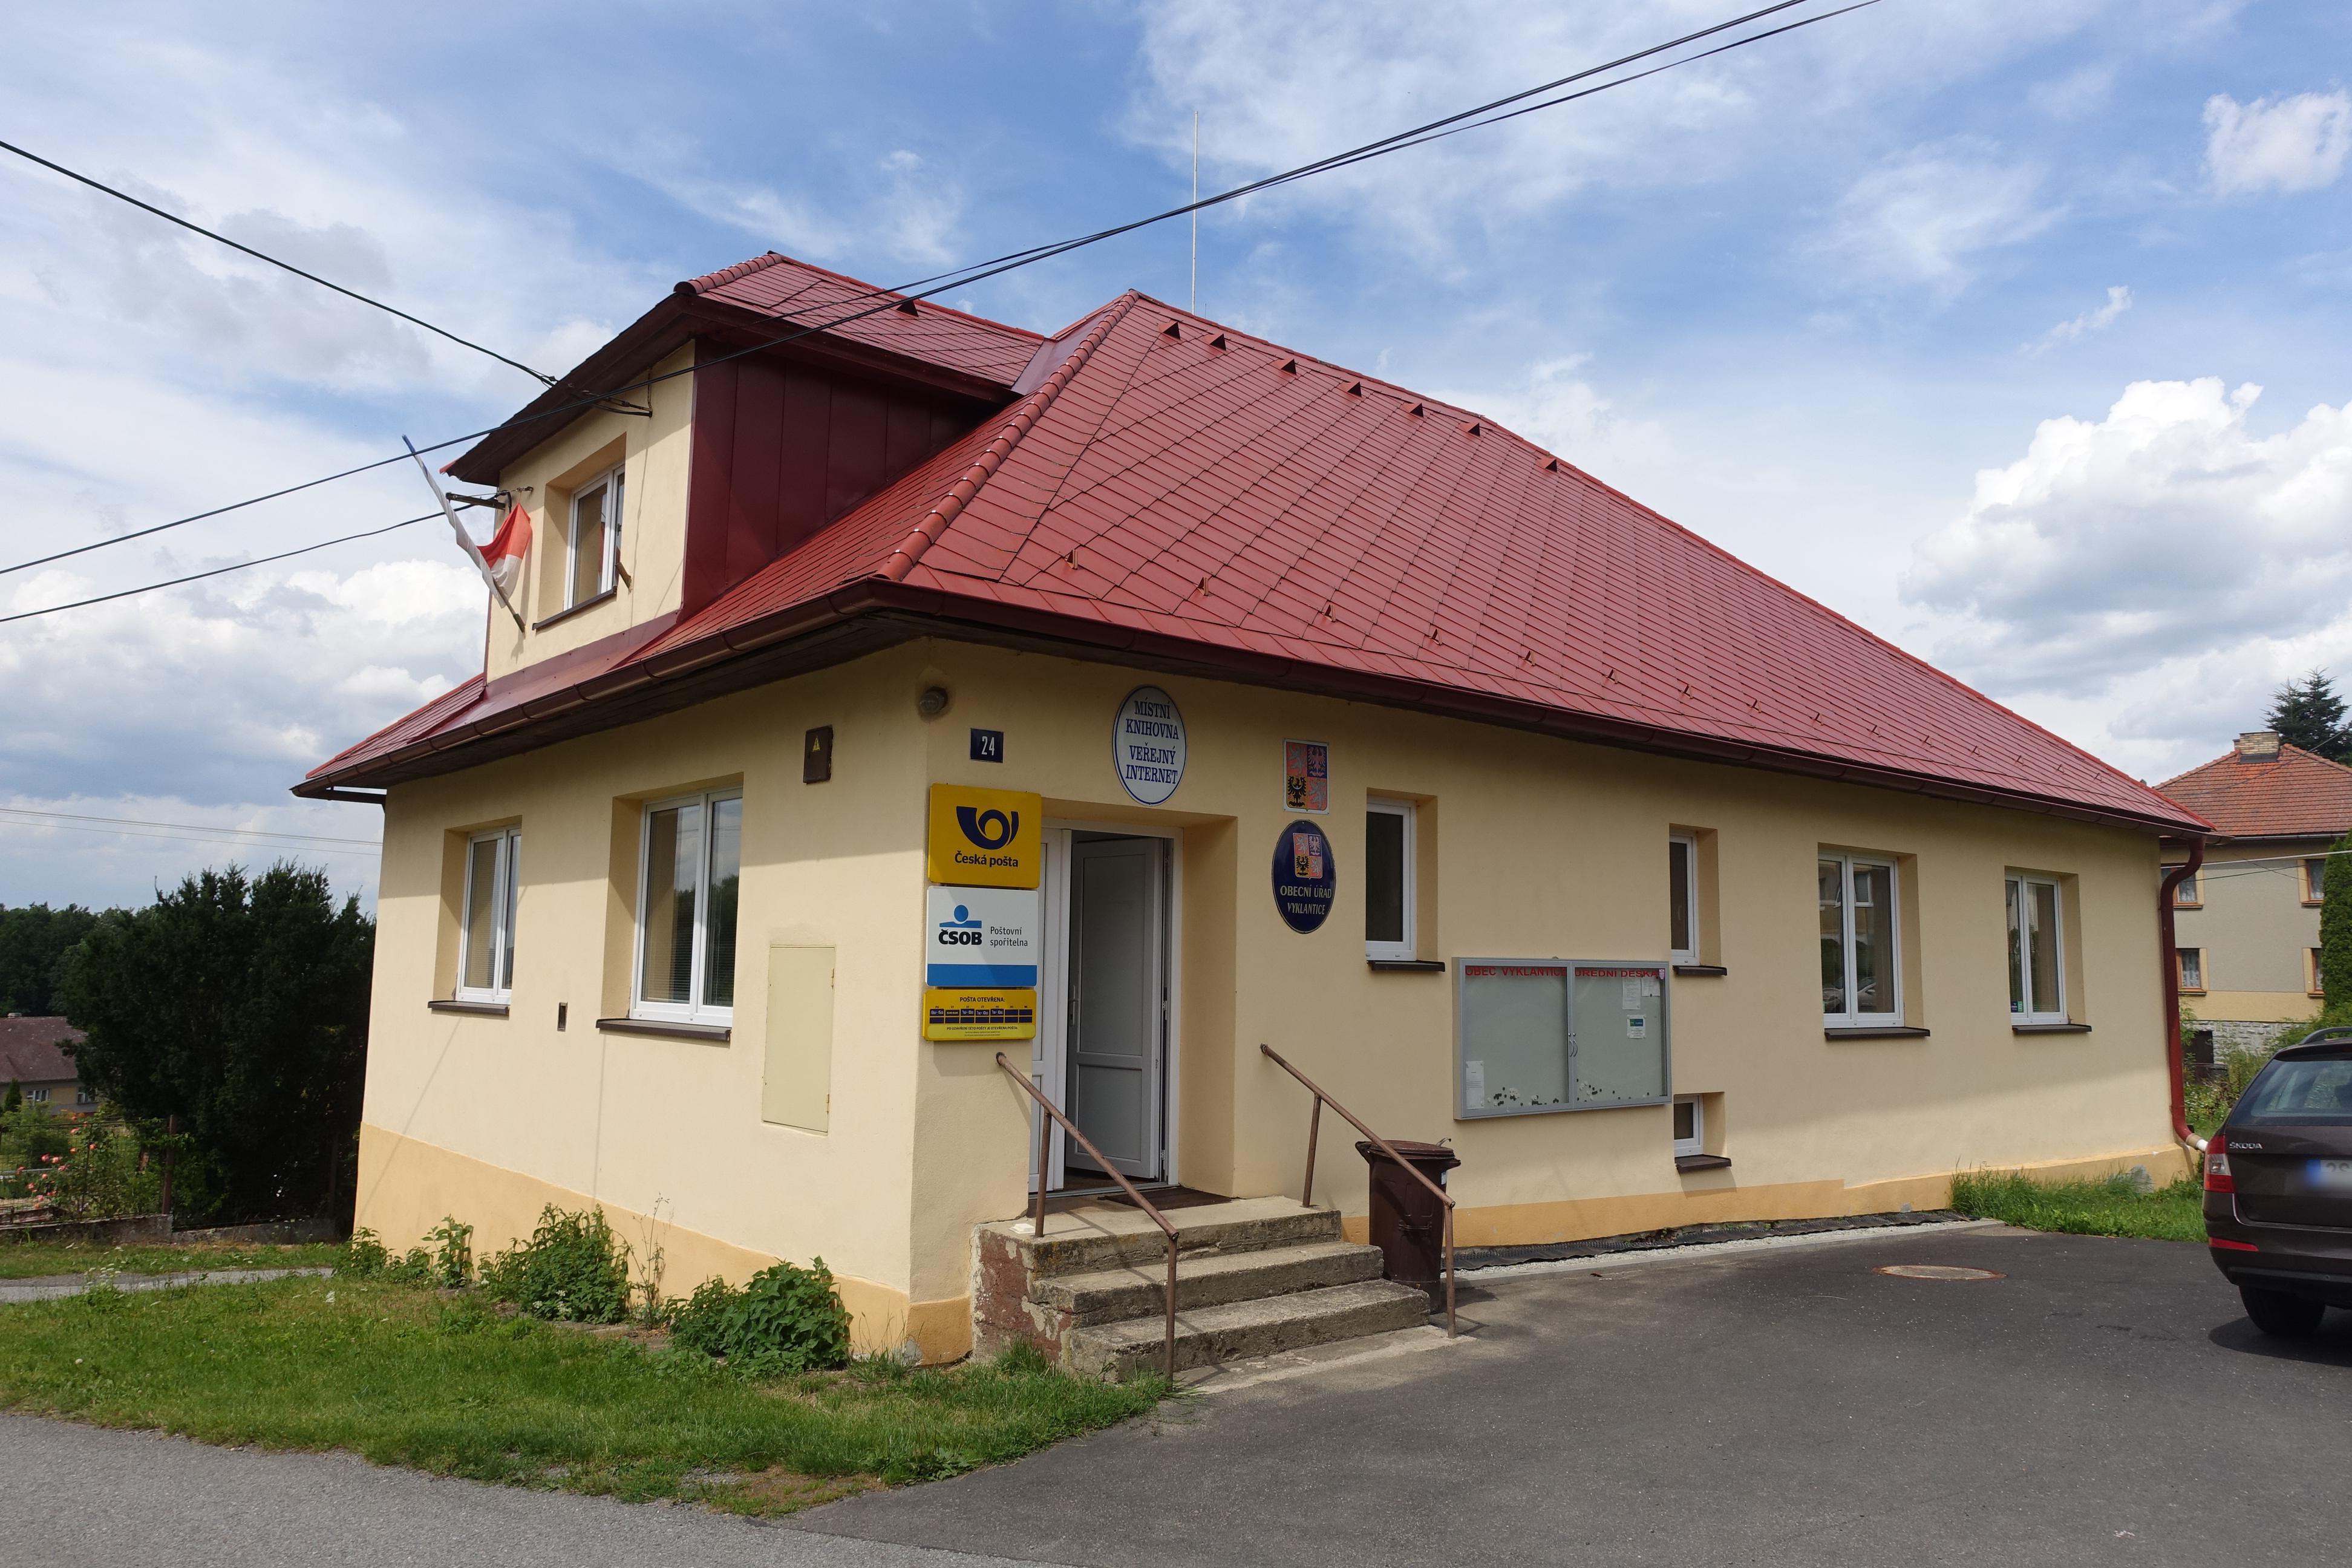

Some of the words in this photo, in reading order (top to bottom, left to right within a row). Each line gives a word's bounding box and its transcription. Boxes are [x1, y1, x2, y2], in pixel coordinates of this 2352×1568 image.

[1134, 697, 1171, 719] MÍSTNÍ
[1126, 718, 1179, 740] KNIHOVNA
[981, 736, 995, 756] 24
[1129, 742, 1176, 765] VEŘEJNÝ
[1125, 764, 1178, 784] INTERNET
[955, 851, 987, 865] Česká
[989, 856, 1019, 867] pošta
[1280, 884, 1312, 898] OBECNÍ
[1314, 885, 1331, 898] ÚŘAD
[1287, 902, 1325, 915] VYKLANTICE
[938, 929, 982, 945] ČSOB
[990, 926, 1022, 935] Poštovní
[990, 938, 1028, 948] spořitelna
[1465, 967, 1496, 976] OBEC
[1501, 967, 1567, 976] VYKLANTICE
[1621, 969, 1657, 978] DESKA
